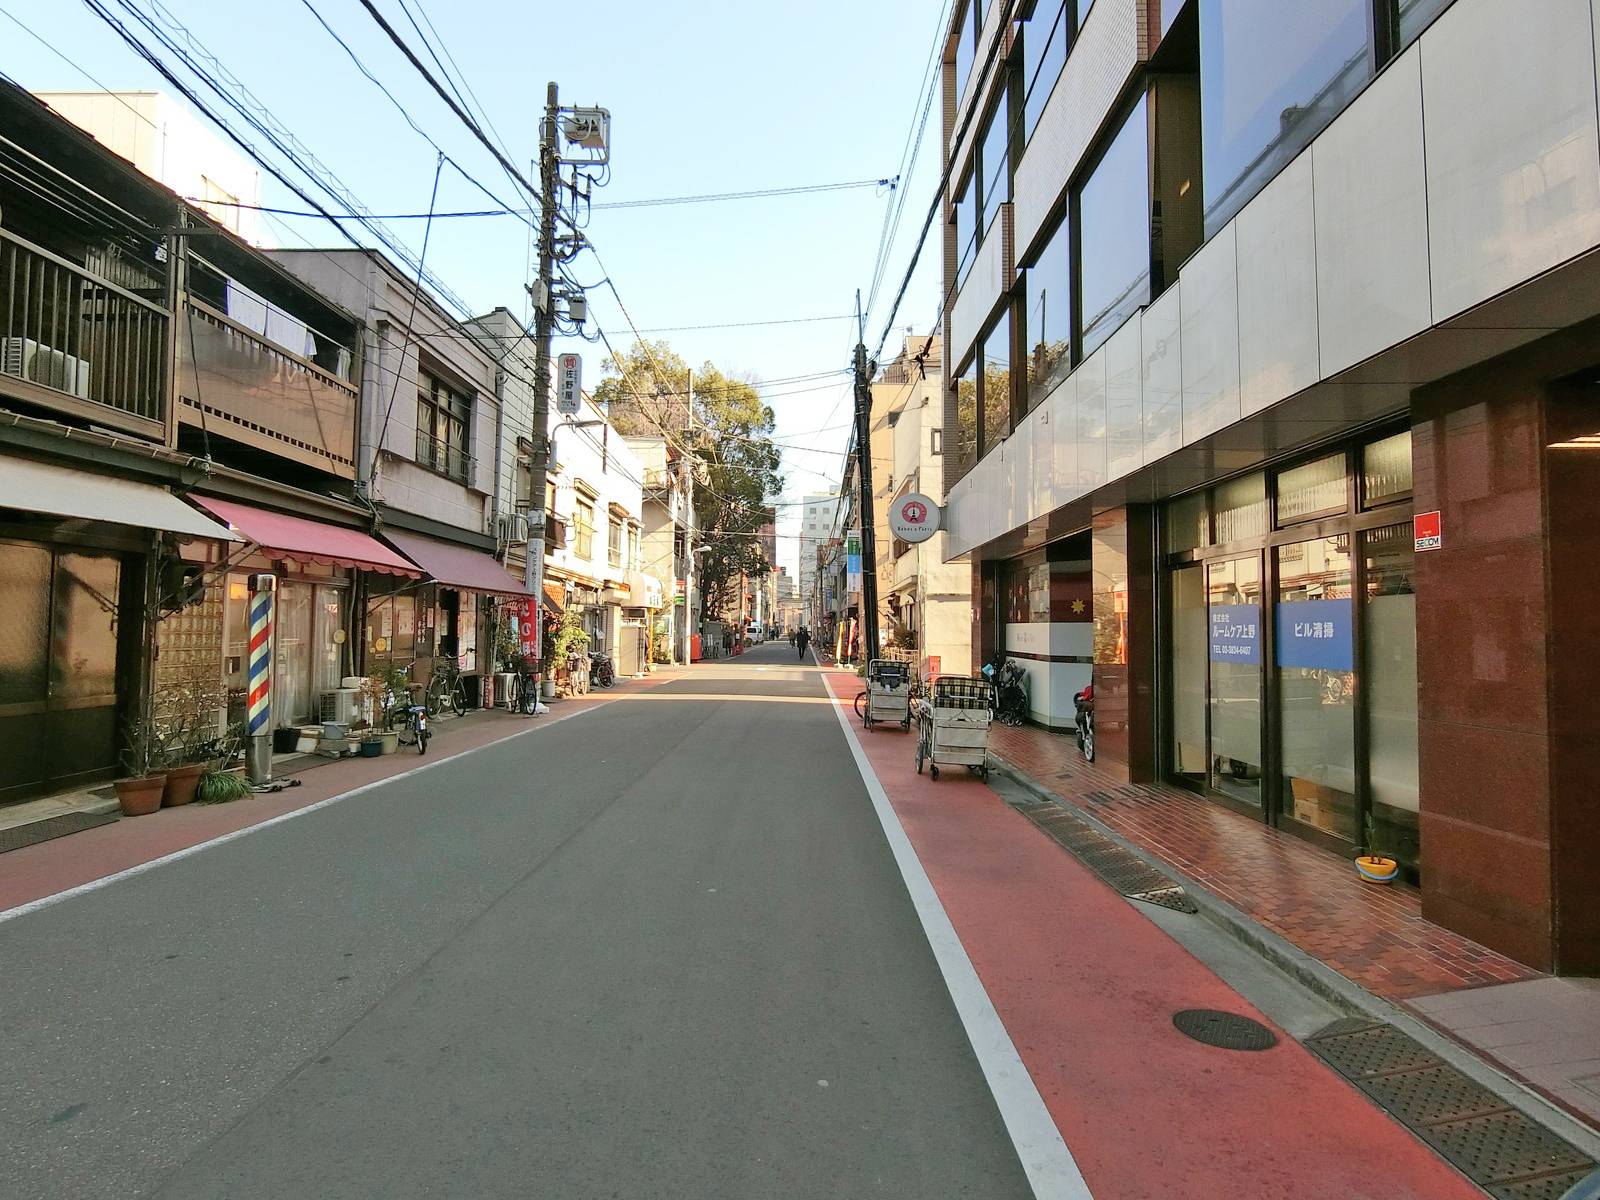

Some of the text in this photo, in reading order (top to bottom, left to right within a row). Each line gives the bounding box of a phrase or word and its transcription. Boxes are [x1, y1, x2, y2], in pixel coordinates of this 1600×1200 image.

[565, 370, 573, 399] 佐野屋
[1416, 537, 1439, 547] SECOM
[1212, 613, 1230, 623] 株式会社
[1212, 624, 1256, 639] ルームケア上野
[1294, 621, 1334, 638] ビル清掃
[1213, 645, 1221, 654] TEL
